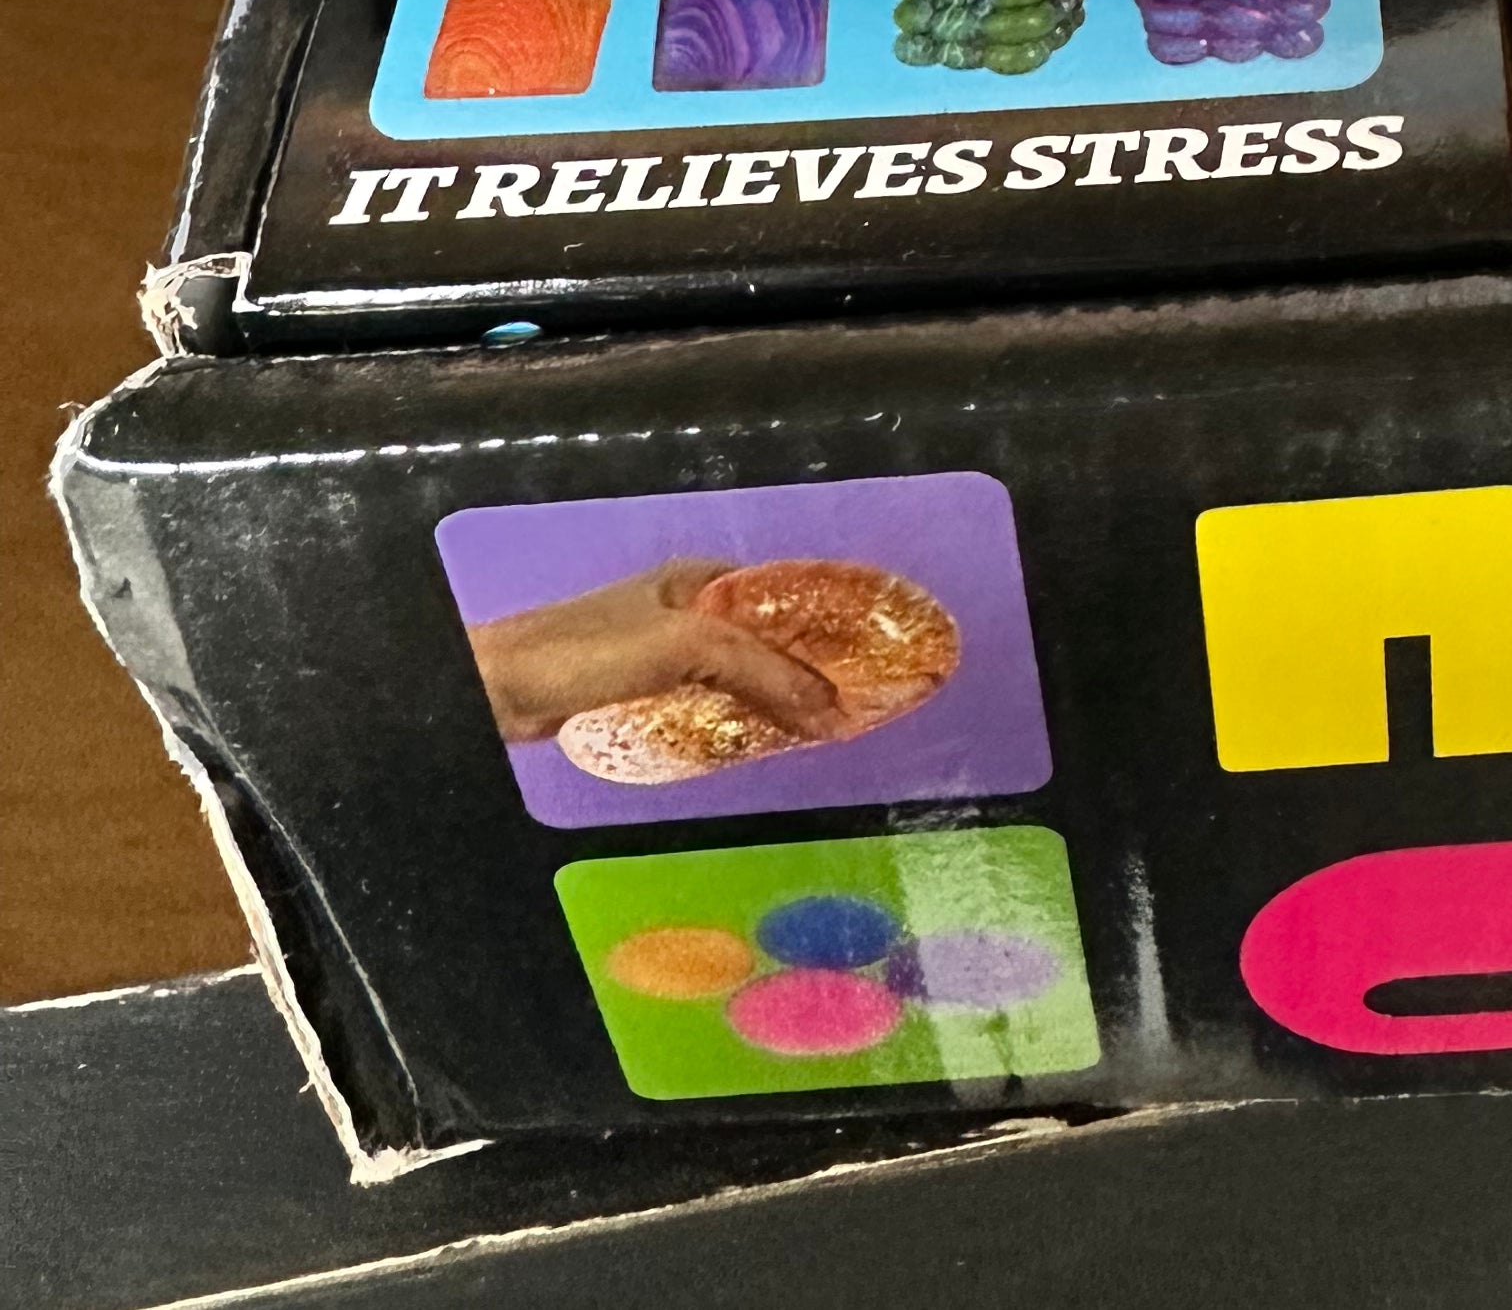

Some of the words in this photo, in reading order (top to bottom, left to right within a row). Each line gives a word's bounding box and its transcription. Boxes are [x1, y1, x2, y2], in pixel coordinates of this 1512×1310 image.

[328, 165, 459, 226] IT
[455, 139, 994, 221] RELIEVES
[1003, 114, 1406, 191] STRESS
